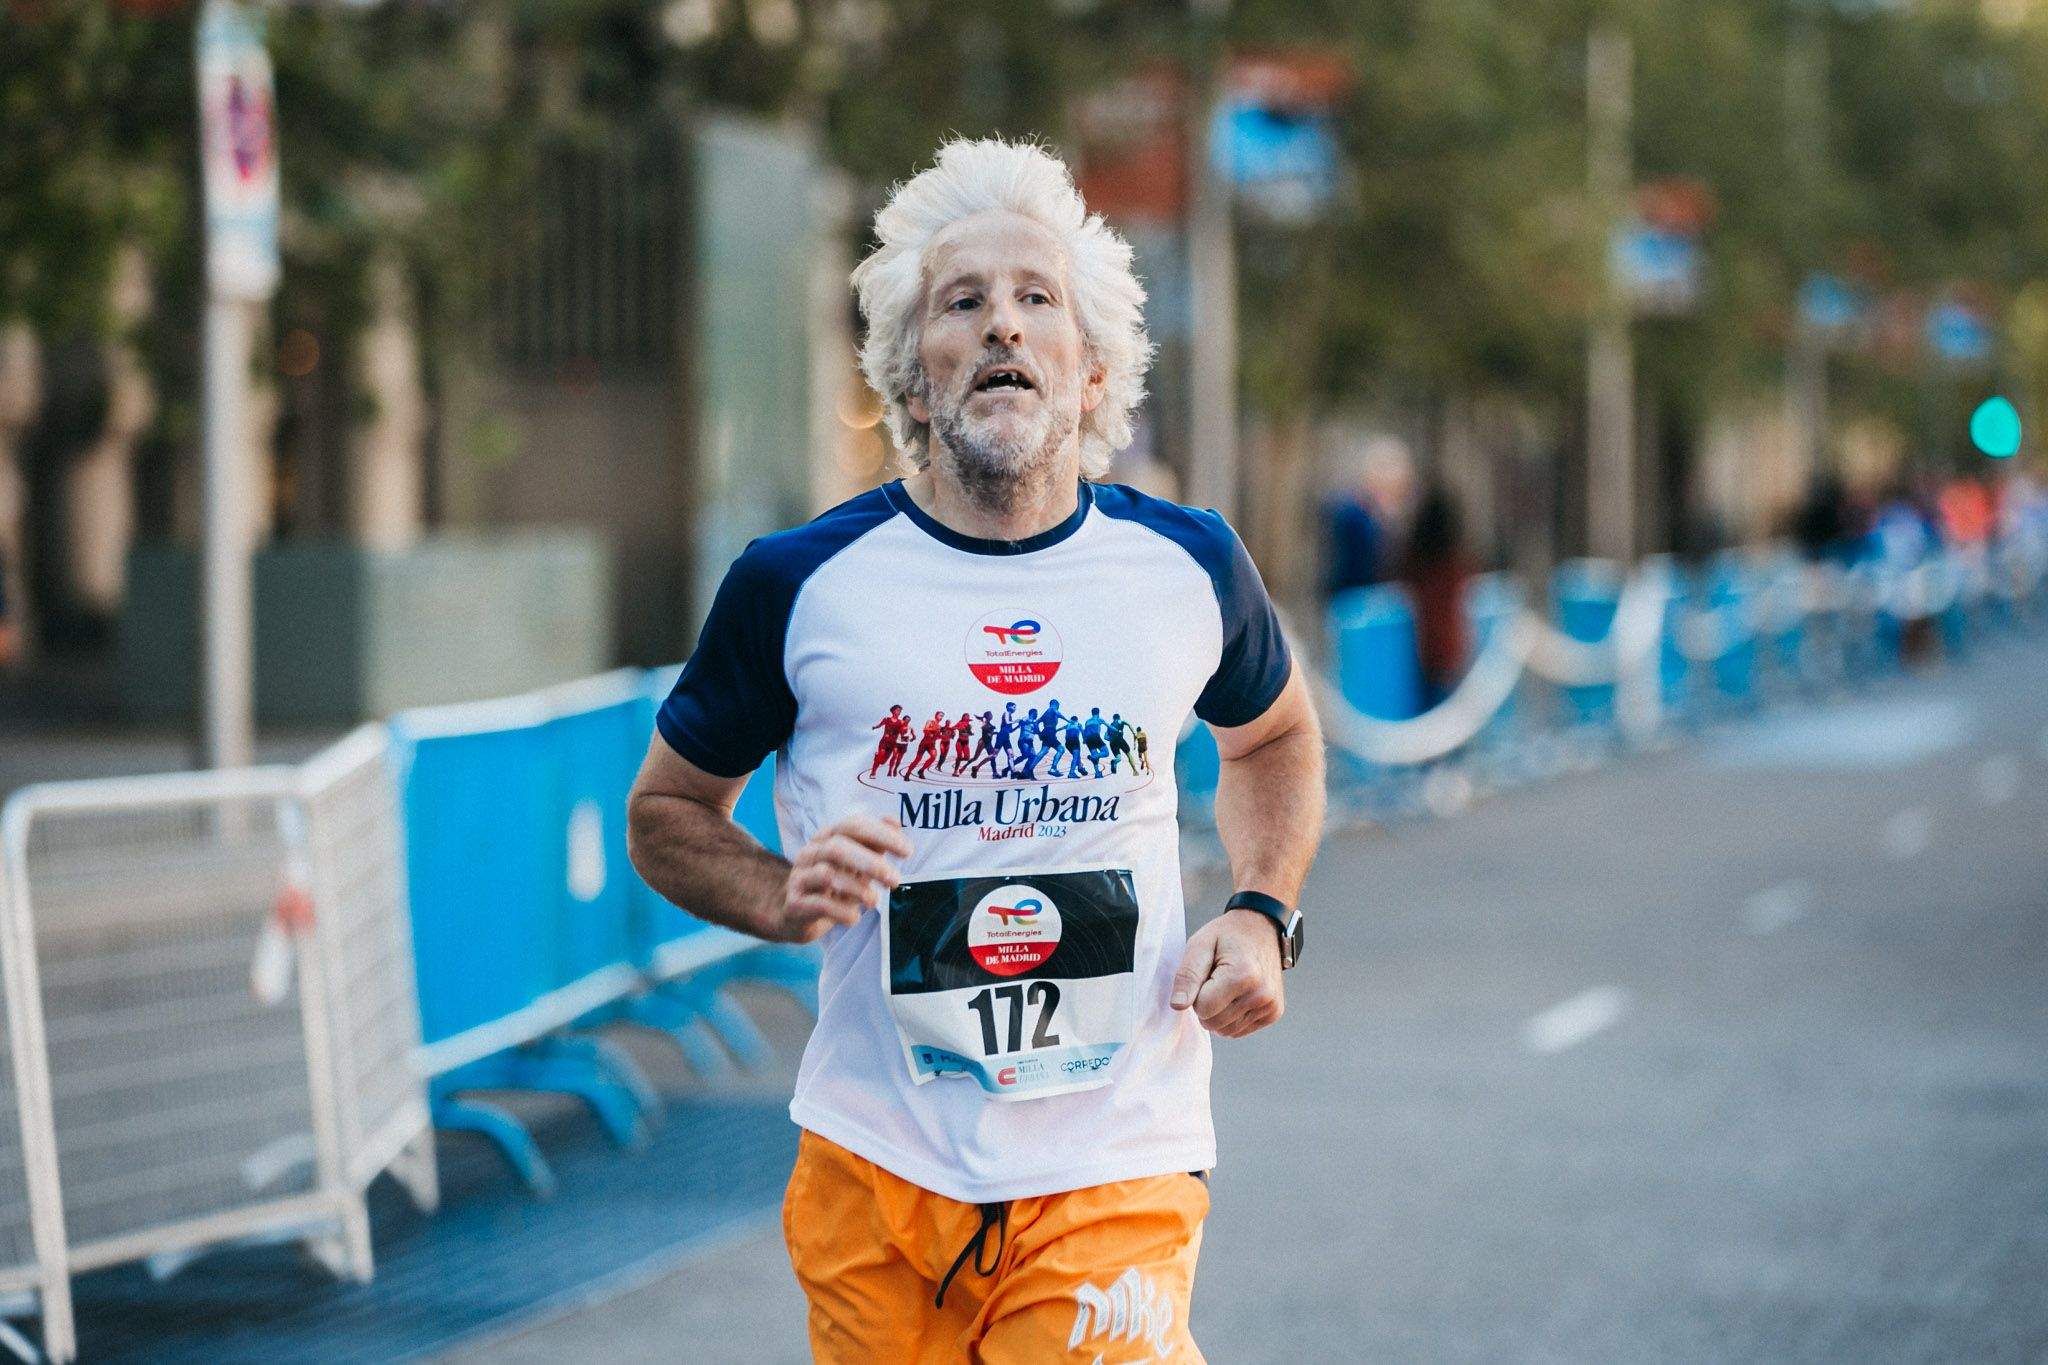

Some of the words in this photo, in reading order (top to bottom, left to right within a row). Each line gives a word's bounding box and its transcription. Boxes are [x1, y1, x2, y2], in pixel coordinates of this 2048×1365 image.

[999, 665, 1032, 673] MILLA
[987, 675, 1001, 683] DE
[1005, 674, 1045, 683] MADRID
[899, 788, 984, 829] Milla
[995, 785, 1120, 825] Urbana
[978, 823, 1034, 841] Madrid
[1038, 826, 1067, 837] 2023
[998, 945, 1029, 953] MILLA
[985, 956, 999, 965] DE
[1001, 954, 1041, 963] MADRID
[968, 981, 1060, 1055] 172
